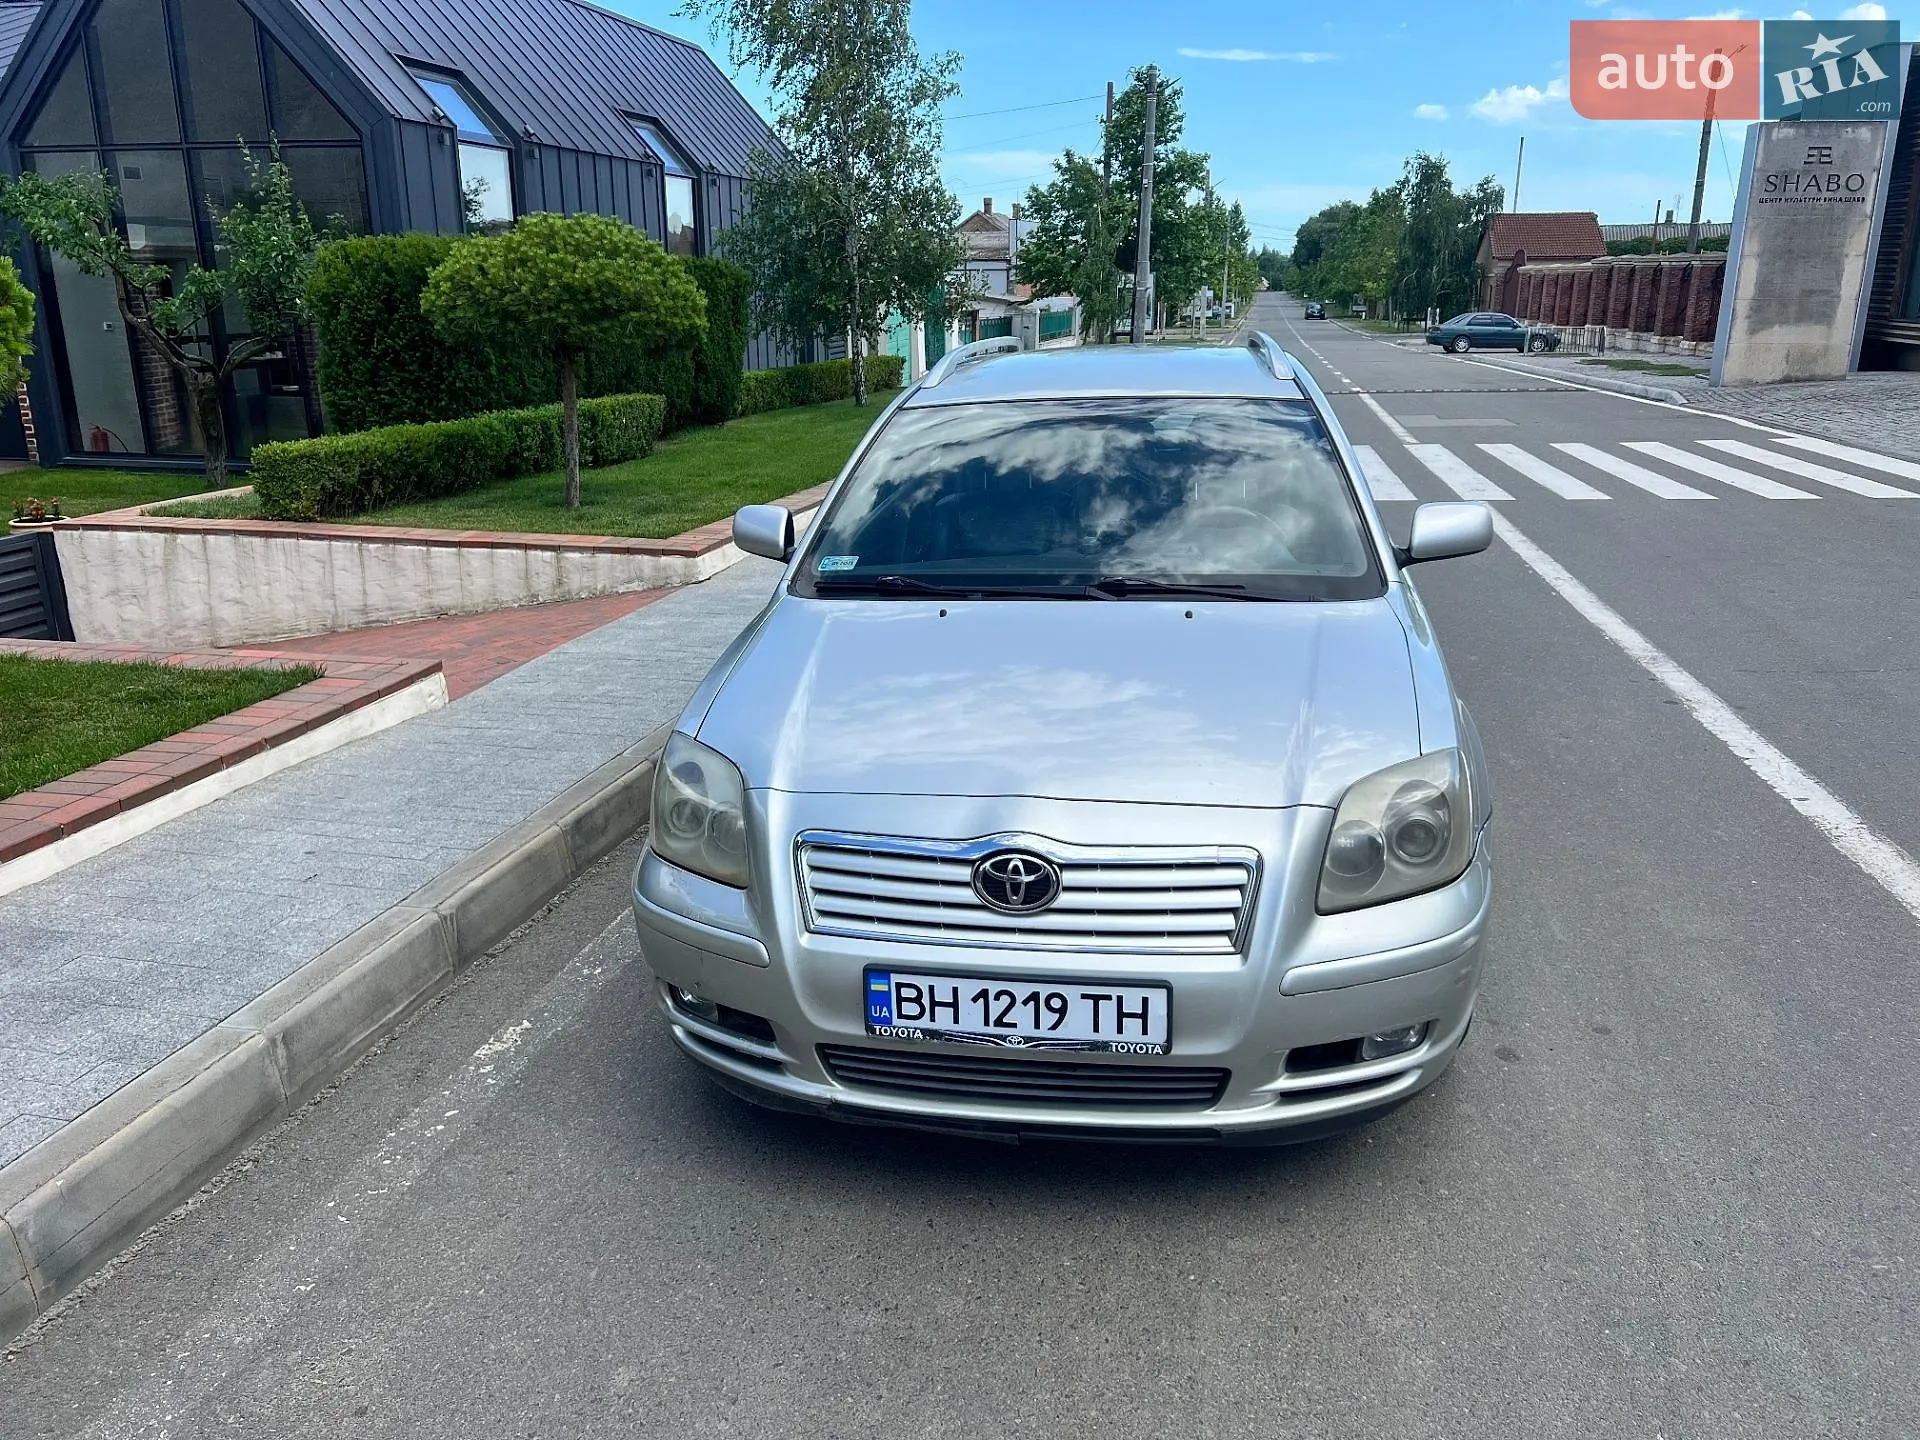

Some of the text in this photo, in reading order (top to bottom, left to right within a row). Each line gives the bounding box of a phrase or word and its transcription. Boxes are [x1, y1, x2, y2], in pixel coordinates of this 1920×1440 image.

[1763, 173, 1865, 193] SHABO
[1758, 196, 1783, 204] ЦЕНТР
[871, 1005, 891, 1018] UA
[894, 981, 1150, 1036] BH 1219 TH
[873, 1025, 924, 1040] TOYOTA
[1110, 1042, 1164, 1056] TOYOTA
